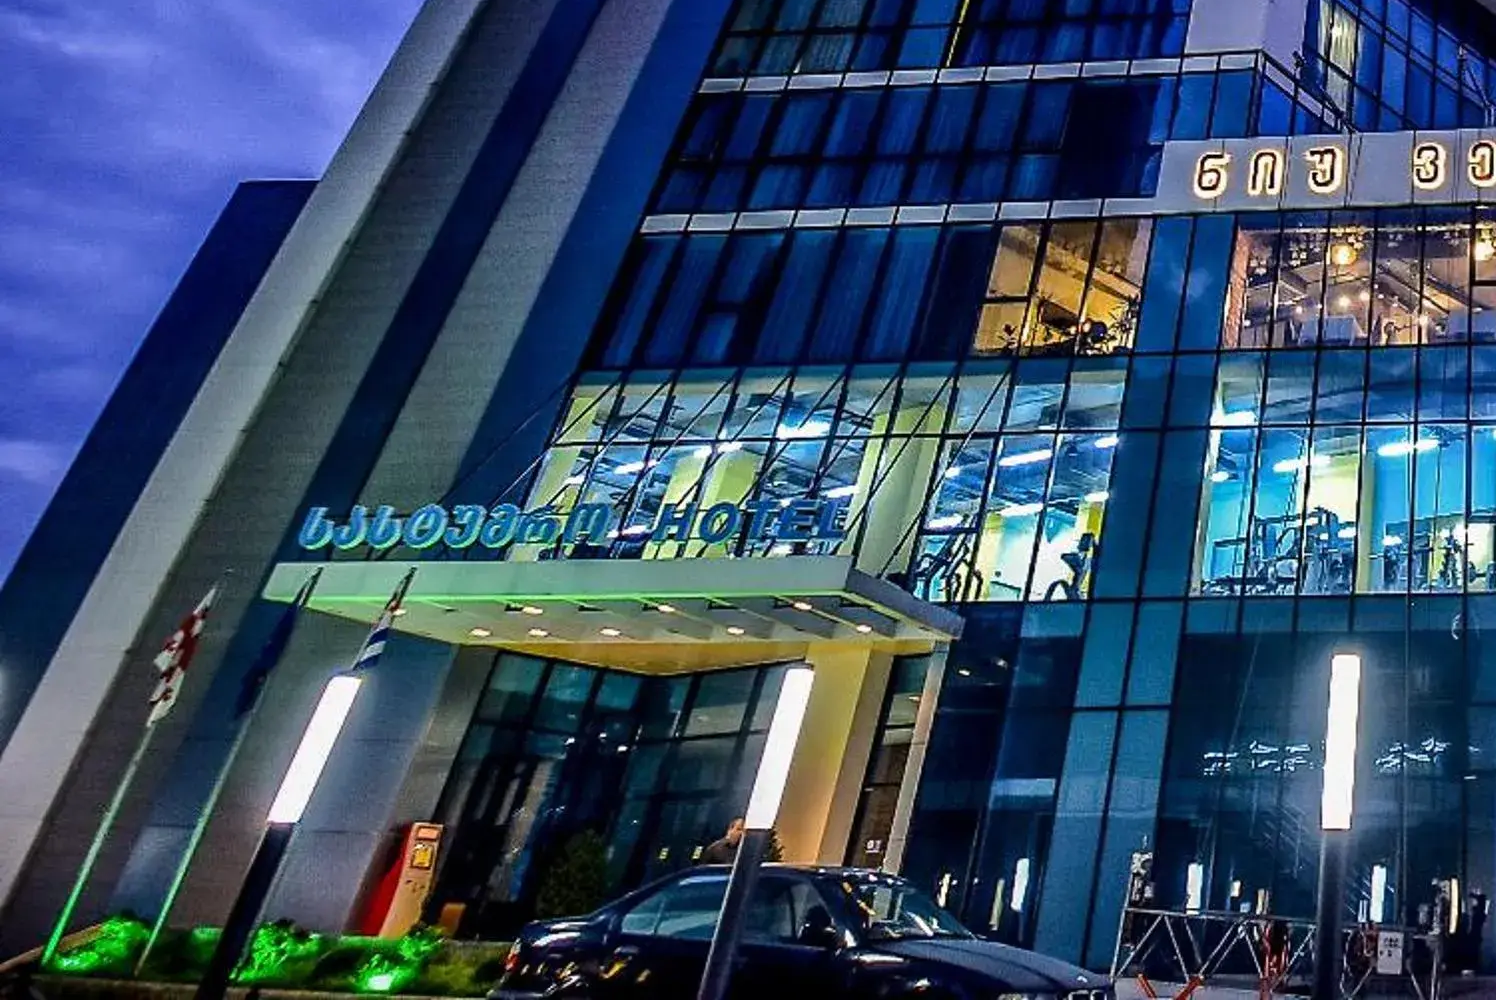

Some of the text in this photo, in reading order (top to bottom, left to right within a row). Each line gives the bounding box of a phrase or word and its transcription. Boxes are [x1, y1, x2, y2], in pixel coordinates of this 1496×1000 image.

[1194, 147, 1343, 198] ნიუ
[299, 496, 852, 549] სასტუმრო HOTEL
